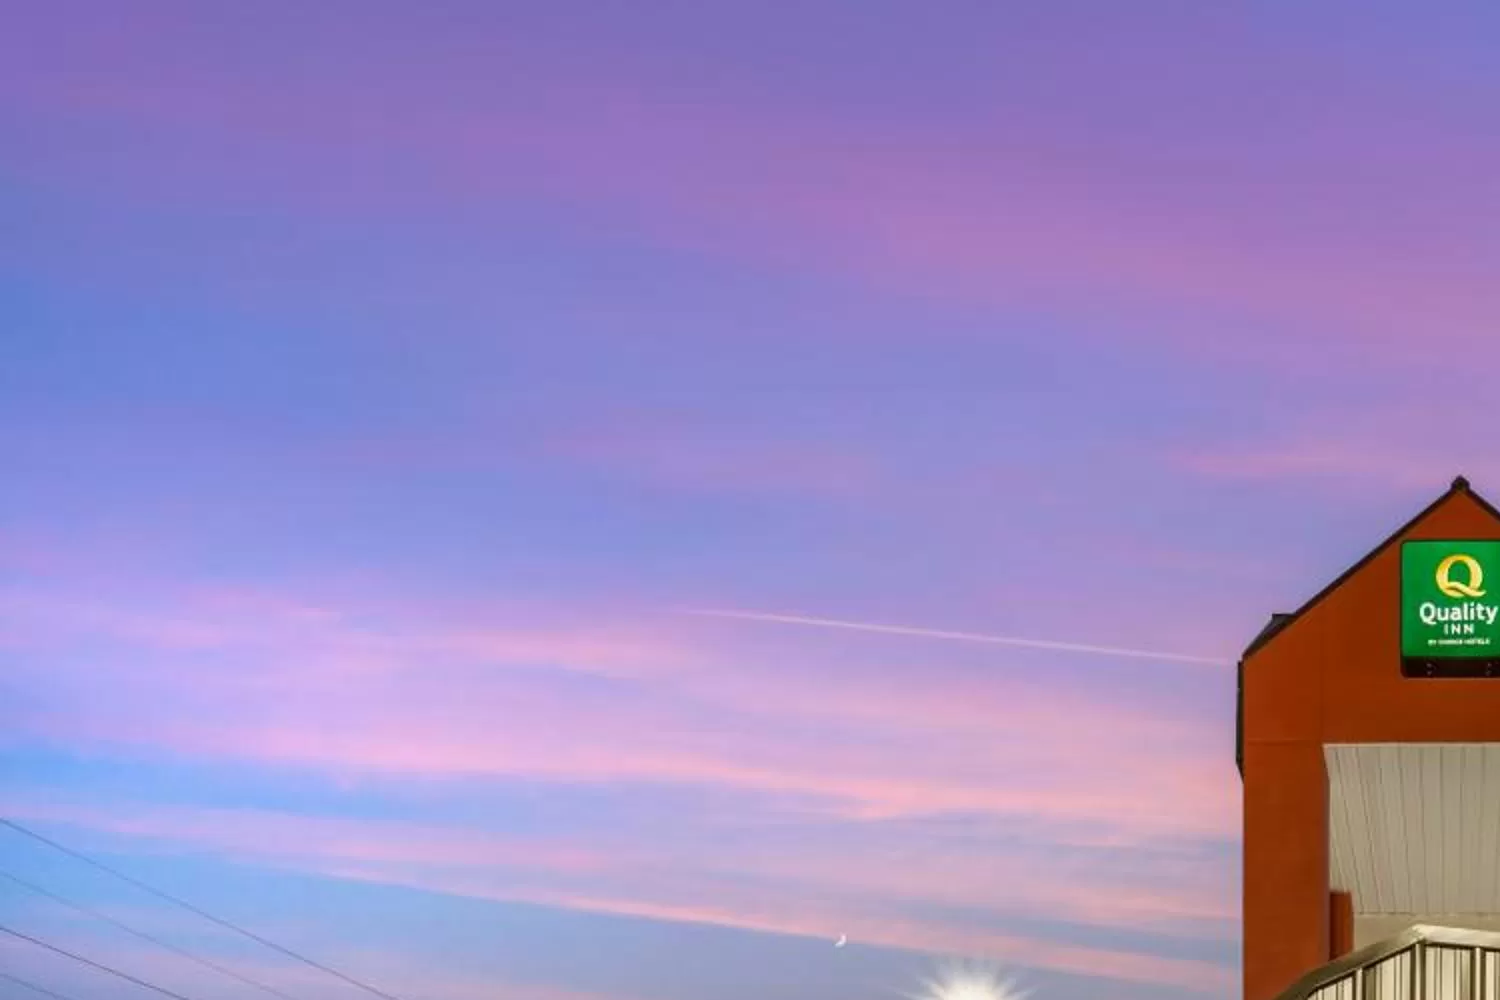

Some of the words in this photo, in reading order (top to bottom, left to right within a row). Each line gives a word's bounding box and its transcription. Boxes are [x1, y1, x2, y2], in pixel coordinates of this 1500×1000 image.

[1435, 553, 1487, 598] Q
[1419, 602, 1499, 625] Quality
[1443, 623, 1475, 635] INN
